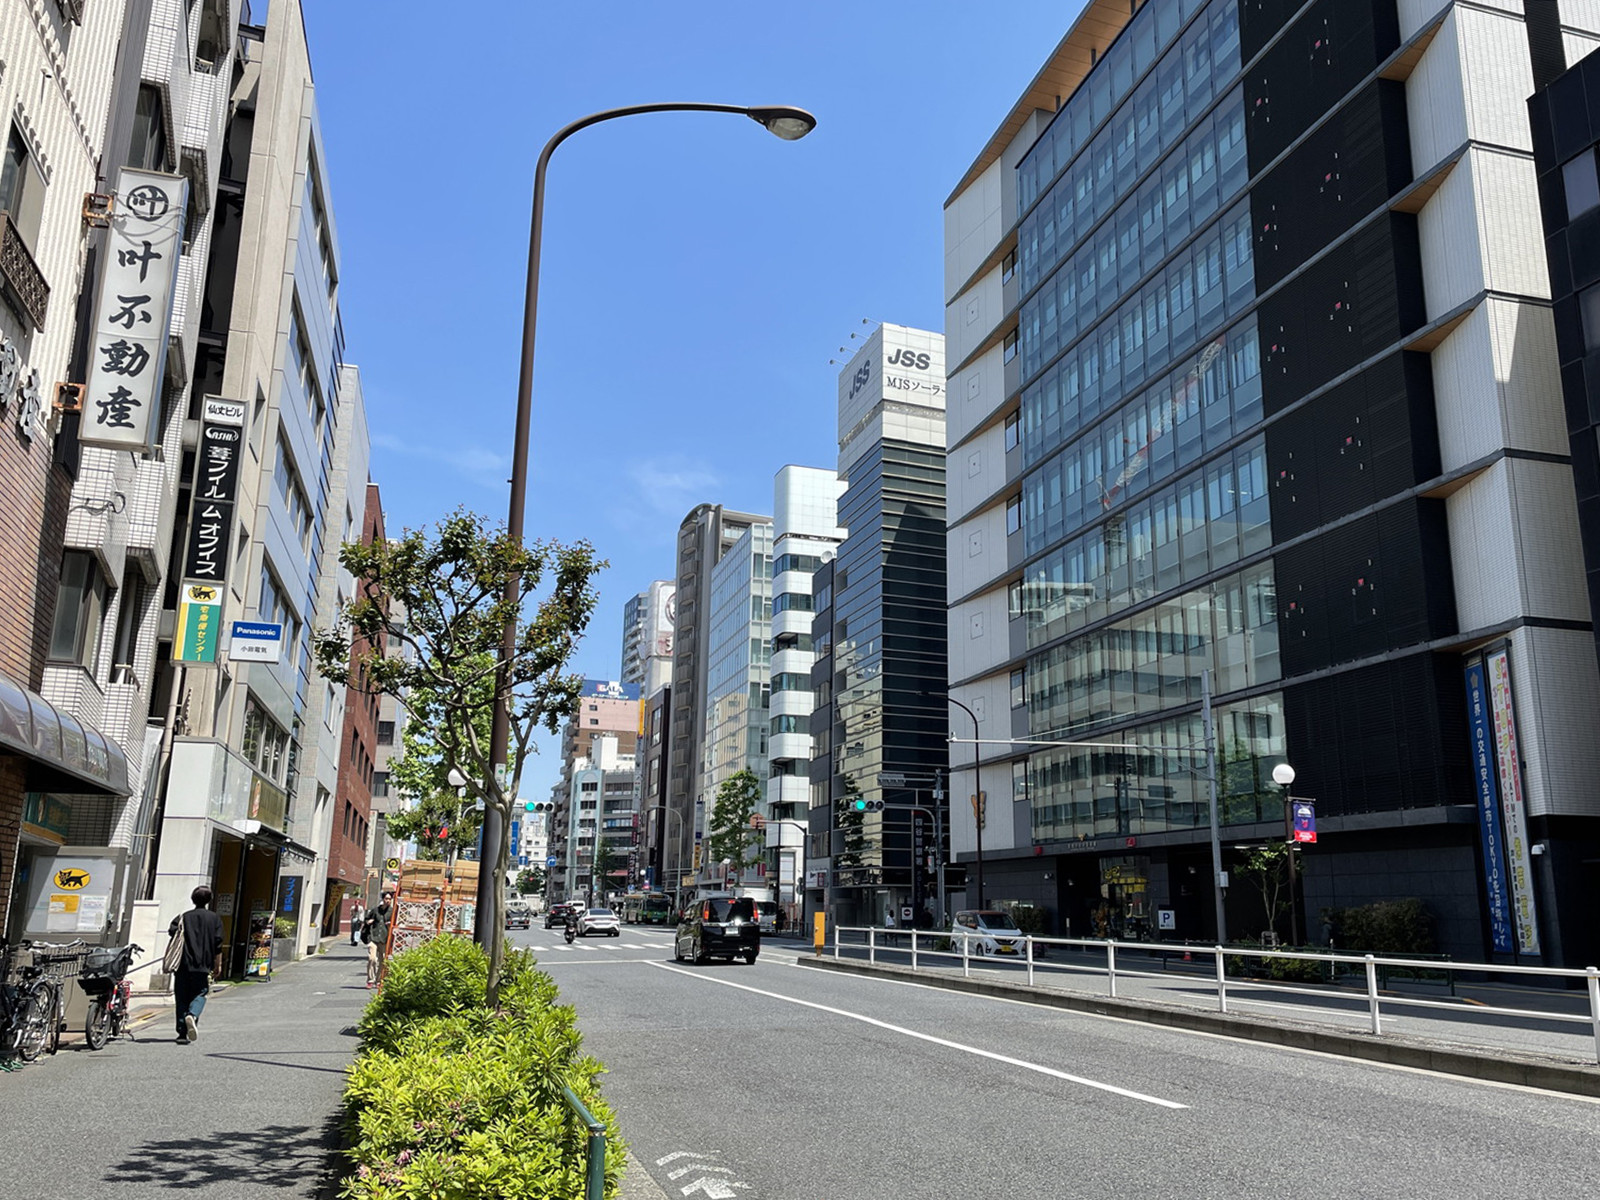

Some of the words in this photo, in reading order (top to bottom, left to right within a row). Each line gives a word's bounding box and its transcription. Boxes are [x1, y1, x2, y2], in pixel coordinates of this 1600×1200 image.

[95, 240, 163, 429] 叶不動産
[888, 348, 931, 371] JSS
[848, 359, 871, 400] JSS
[886, 376, 946, 396] MJSソーラ
[208, 404, 242, 418] 仙丈ビル
[195, 605, 210, 661] 宅急便センター
[236, 627, 276, 636] Panasonic
[1163, 912, 1170, 923] P
